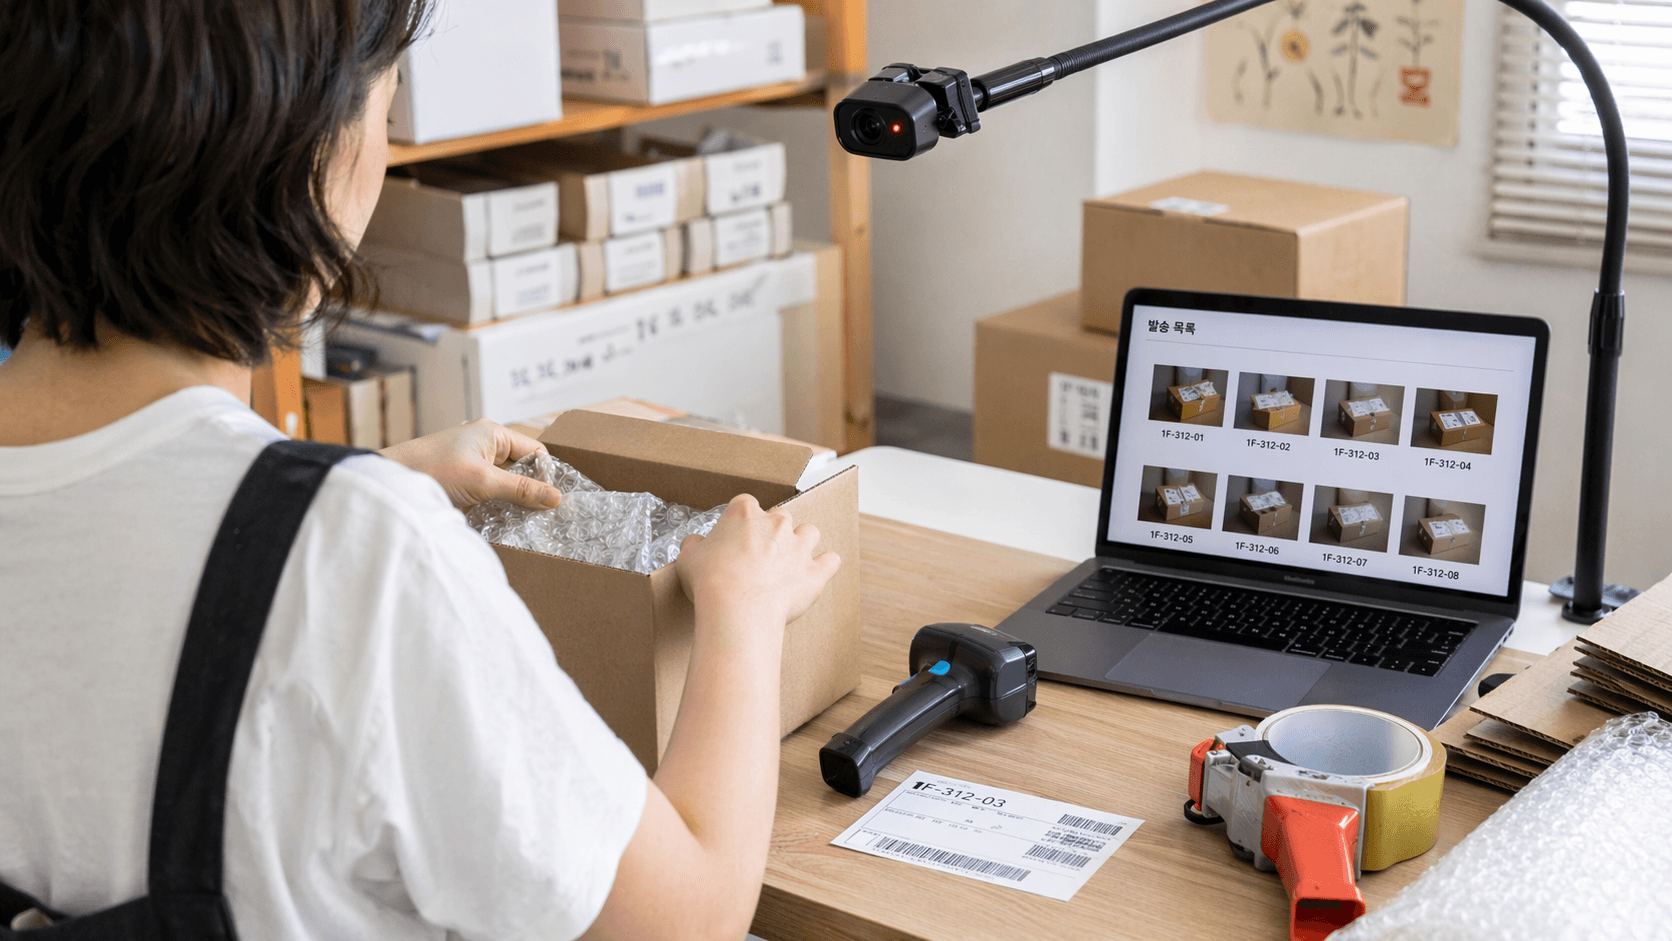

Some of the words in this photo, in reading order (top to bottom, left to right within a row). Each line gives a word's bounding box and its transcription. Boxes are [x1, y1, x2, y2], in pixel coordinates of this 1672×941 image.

[1148, 319, 1170, 334] 발송
[1173, 321, 1196, 336] 목록
[1161, 429, 1204, 442] 1F-312-01
[1246, 438, 1291, 452] 1F-312-02
[1333, 447, 1380, 461] 1F-312-03
[1424, 457, 1472, 471] 1F-312-04
[1150, 530, 1194, 545] 1F-312-05
[1235, 541, 1280, 556] 1F-312-06
[1322, 553, 1368, 567] 1F-312-07
[1412, 565, 1460, 580] 1F-312-08
[911, 780, 1007, 809] 1F-312-03
